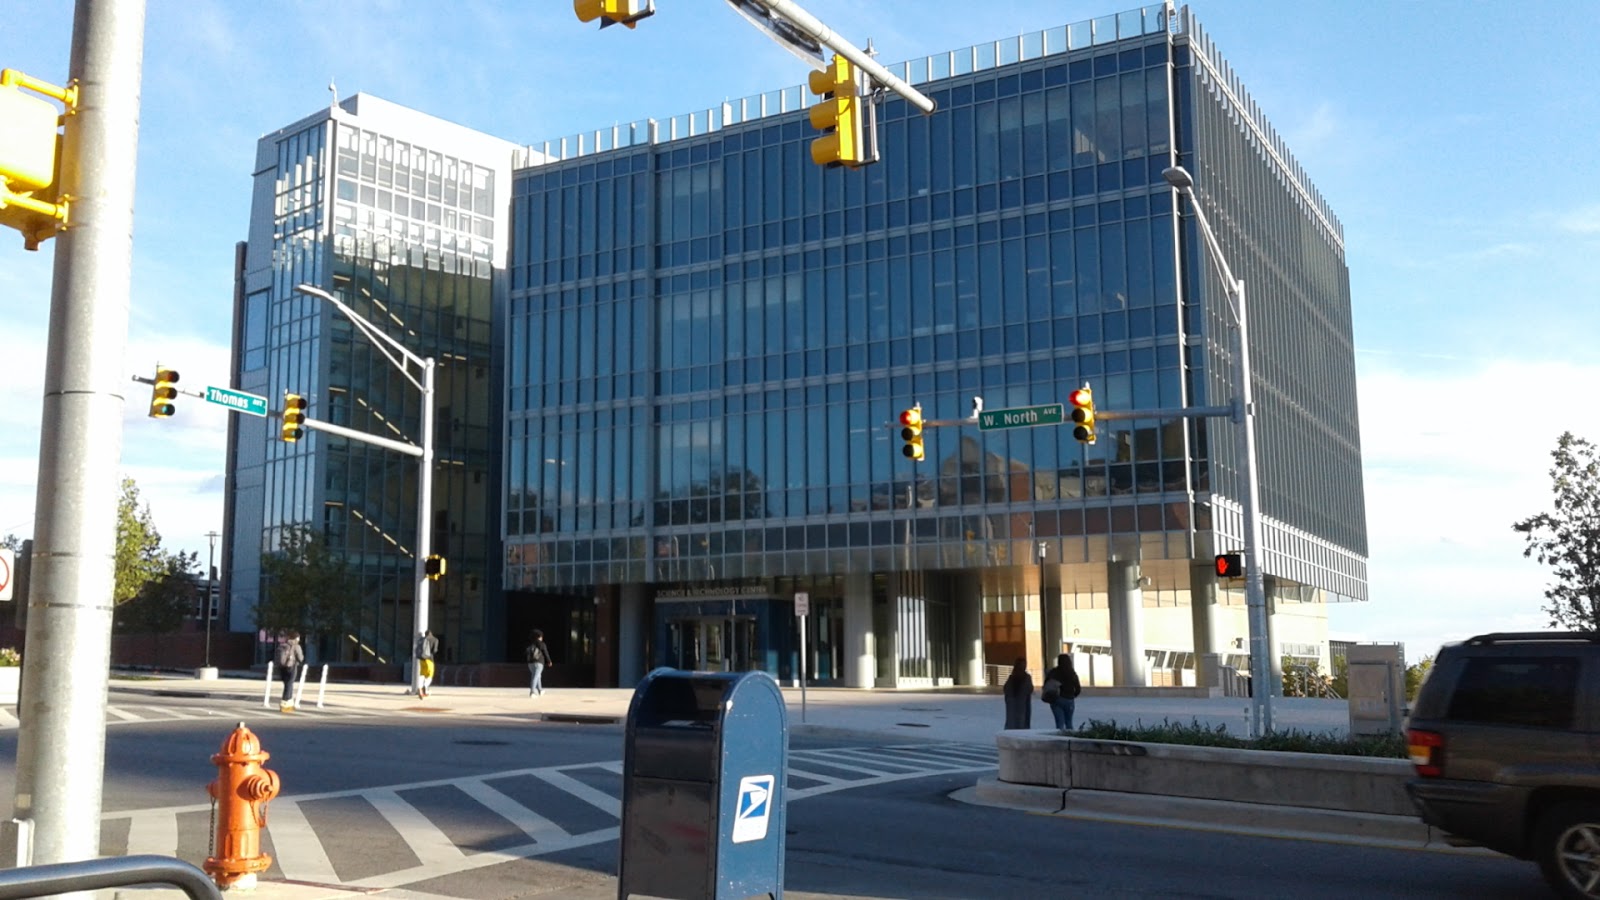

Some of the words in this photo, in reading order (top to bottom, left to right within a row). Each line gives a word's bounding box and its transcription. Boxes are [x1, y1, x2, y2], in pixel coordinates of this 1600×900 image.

[210, 389, 248, 408] Thomas
[983, 415, 999, 427] W.
[1004, 410, 1038, 425] North
[1043, 407, 1057, 415] AVE
[656, 589, 685, 597] SCIENCE
[693, 587, 739, 596] TECHNOLOGY
[741, 586, 767, 595] CENTER
